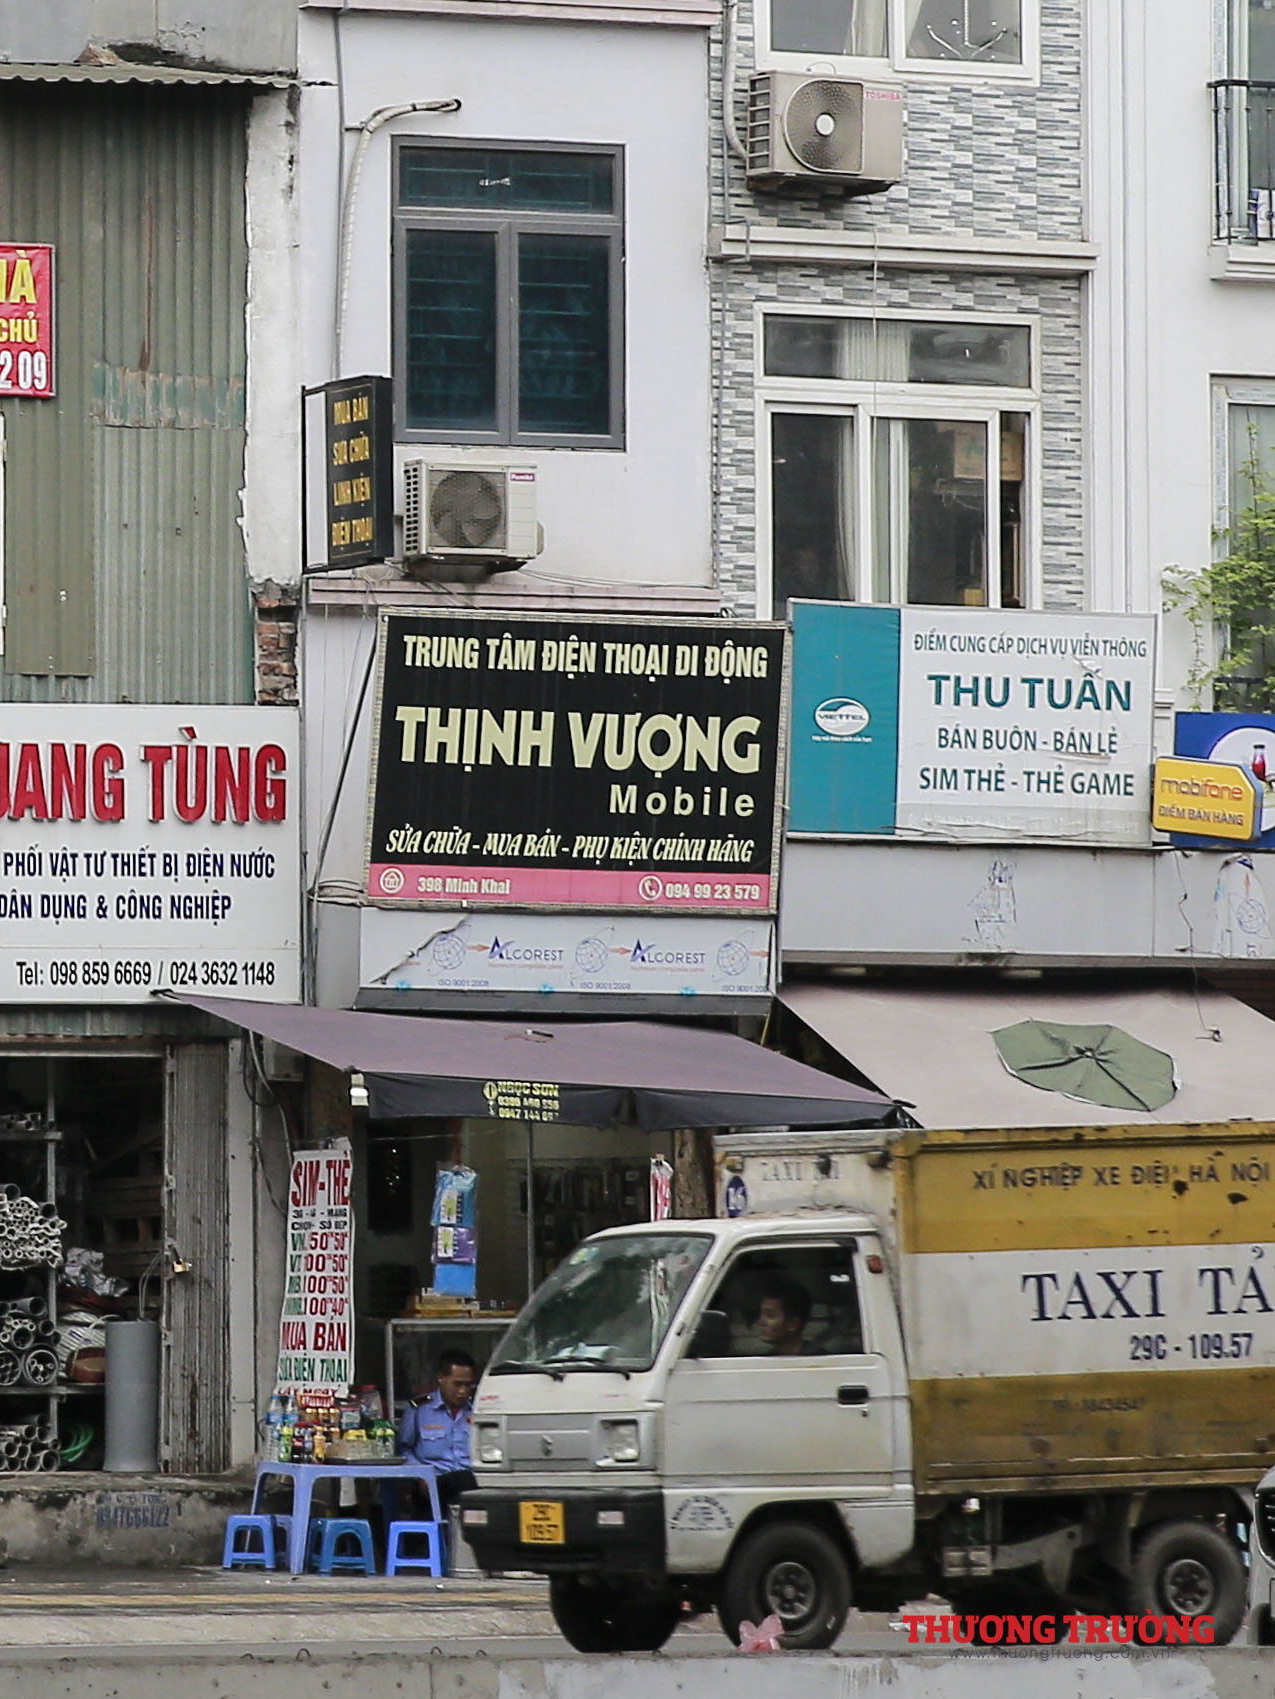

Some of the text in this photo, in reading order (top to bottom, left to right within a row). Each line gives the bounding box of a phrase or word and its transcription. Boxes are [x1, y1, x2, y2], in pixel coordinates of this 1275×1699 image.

[865, 91, 901, 101] TOSHIBA
[18, 351, 47, 390] 09
[403, 632, 768, 684] TRUNG TÂM ĐIỆN THOẠI DI ĐỘNG
[914, 628, 1147, 659] ĐIỂM CUNG CẤP DỊCH VỤ VIỄN THÔNG
[927, 668, 1131, 711] THU TUẤN
[395, 705, 761, 778] THỊNH VƯỢNG
[938, 723, 1118, 754] BÁN BUÔN BÁN LẺ
[140, 726, 288, 824] TÙNG
[919, 762, 1134, 796] SIM THẺ THẺ GAME
[1160, 777, 1243, 801] mobifone
[609, 784, 755, 817] Mobile
[1213, 808, 1244, 826] HÀNG
[386, 823, 422, 853] SỬA
[423, 825, 472, 855] CHỮA
[482, 832, 523, 856] MUA
[523, 828, 562, 858] BÁN
[572, 835, 609, 865] PHỤ
[610, 830, 653, 866] KIỆN
[652, 832, 707, 862] CHÍNH
[707, 834, 755, 863] HÃNG
[3, 844, 42, 877] PHỐI
[49, 846, 78, 883] VẬT
[84, 851, 107, 877] TƯ
[111, 845, 156, 878] THIẾT
[163, 853, 178, 883] BỊ
[186, 847, 224, 884] ĐIỆN
[230, 846, 275, 878] NƯỚC
[418, 876, 510, 895] 398 Minh Khai
[665, 883, 760, 900] 094 99 23 579
[40, 894, 87, 925] DỤNG
[96, 895, 108, 919] &
[116, 889, 162, 920] CÔNG
[170, 889, 232, 926] NGHIỆP
[488, 936, 564, 961] ALCOREST
[631, 938, 706, 963] ALCOREST
[16, 961, 44, 985] Tel:
[50, 961, 78, 985] 098
[82, 961, 110, 985] 859
[114, 961, 152, 985] 6669
[170, 961, 197, 985] 024
[201, 961, 238, 985] 3632
[242, 961, 275, 985] 1148
[497, 1081, 531, 1096] NGỌC
[973, 1162, 998, 1189] XÍ
[1002, 1162, 1084, 1190] NGHIỆP
[1092, 1166, 1121, 1186] XE
[1189, 1156, 1220, 1183] HÀ
[1230, 1156, 1270, 1187] NỘI
[1022, 1269, 1166, 1322] TAXI
[281, 1315, 346, 1351] MUA BÁN
[1130, 1334, 1167, 1361] 29C
[1190, 1331, 1253, 1359] 109.57
